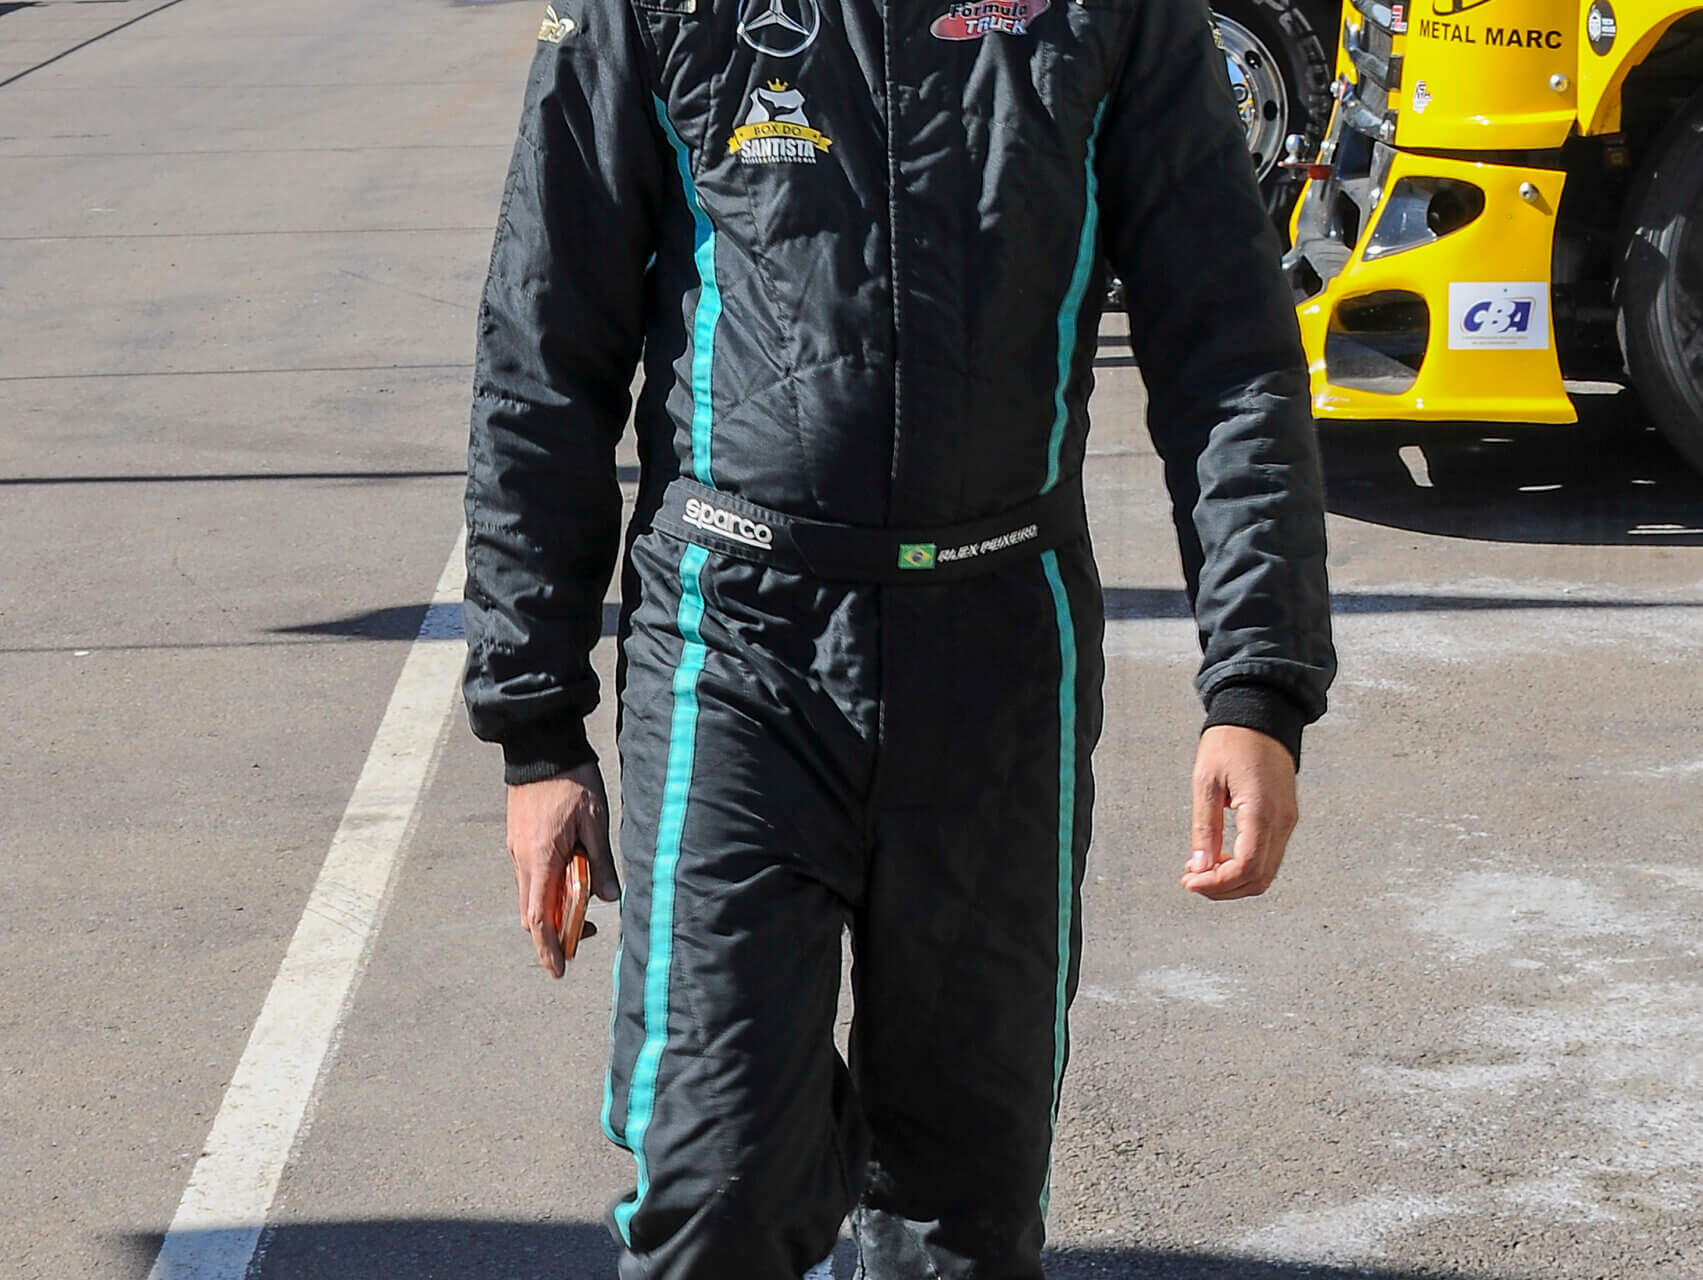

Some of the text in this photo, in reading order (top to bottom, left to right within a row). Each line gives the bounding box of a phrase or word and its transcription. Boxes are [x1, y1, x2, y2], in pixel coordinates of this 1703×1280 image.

[1419, 18, 1476, 43] METAL
[1485, 27, 1563, 49] MARC
[782, 125, 802, 136] DO
[741, 137, 816, 158] SANTISTA
[1464, 300, 1531, 333] CBA
[683, 498, 773, 547] sparco
[937, 543, 980, 563] ALEX
